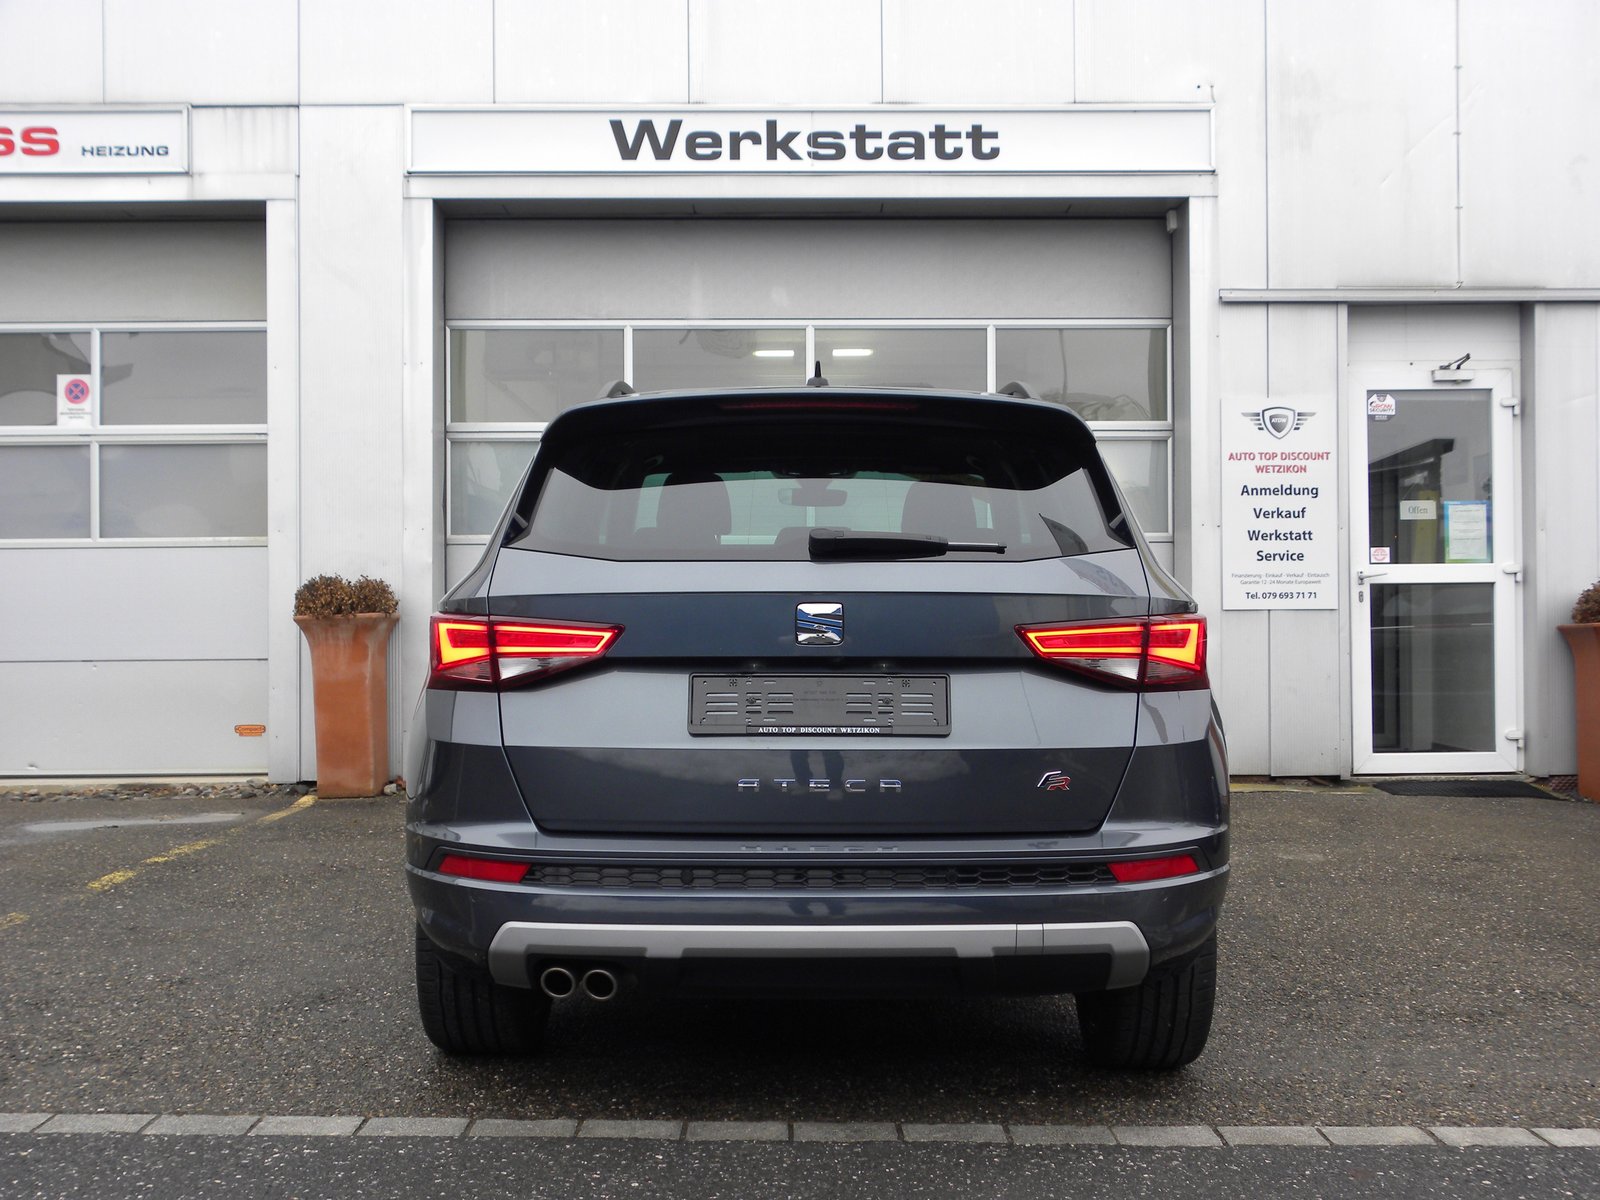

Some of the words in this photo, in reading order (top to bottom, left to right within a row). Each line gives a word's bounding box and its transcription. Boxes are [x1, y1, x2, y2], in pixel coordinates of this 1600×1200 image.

[609, 119, 1000, 161] Werkstatt
[81, 146, 169, 156] HEIZUNG
[1228, 452, 1256, 461] AUTO
[1258, 452, 1278, 461] TOP
[1280, 452, 1331, 461] DISCOUNT
[1255, 464, 1307, 474] WETZIKON
[1240, 484, 1319, 499] Anmeldung
[1253, 507, 1307, 519] Verkauf
[1408, 506, 1428, 514] Offen
[1247, 529, 1313, 541] Werkstatt
[1256, 550, 1305, 562] Service
[1245, 592, 1260, 600] Tel.
[1261, 592, 1278, 600] 079
[1278, 592, 1295, 600] 693
[1296, 592, 1305, 600] 71
[1307, 592, 1317, 600] 71
[737, 778, 902, 793] ATECA
